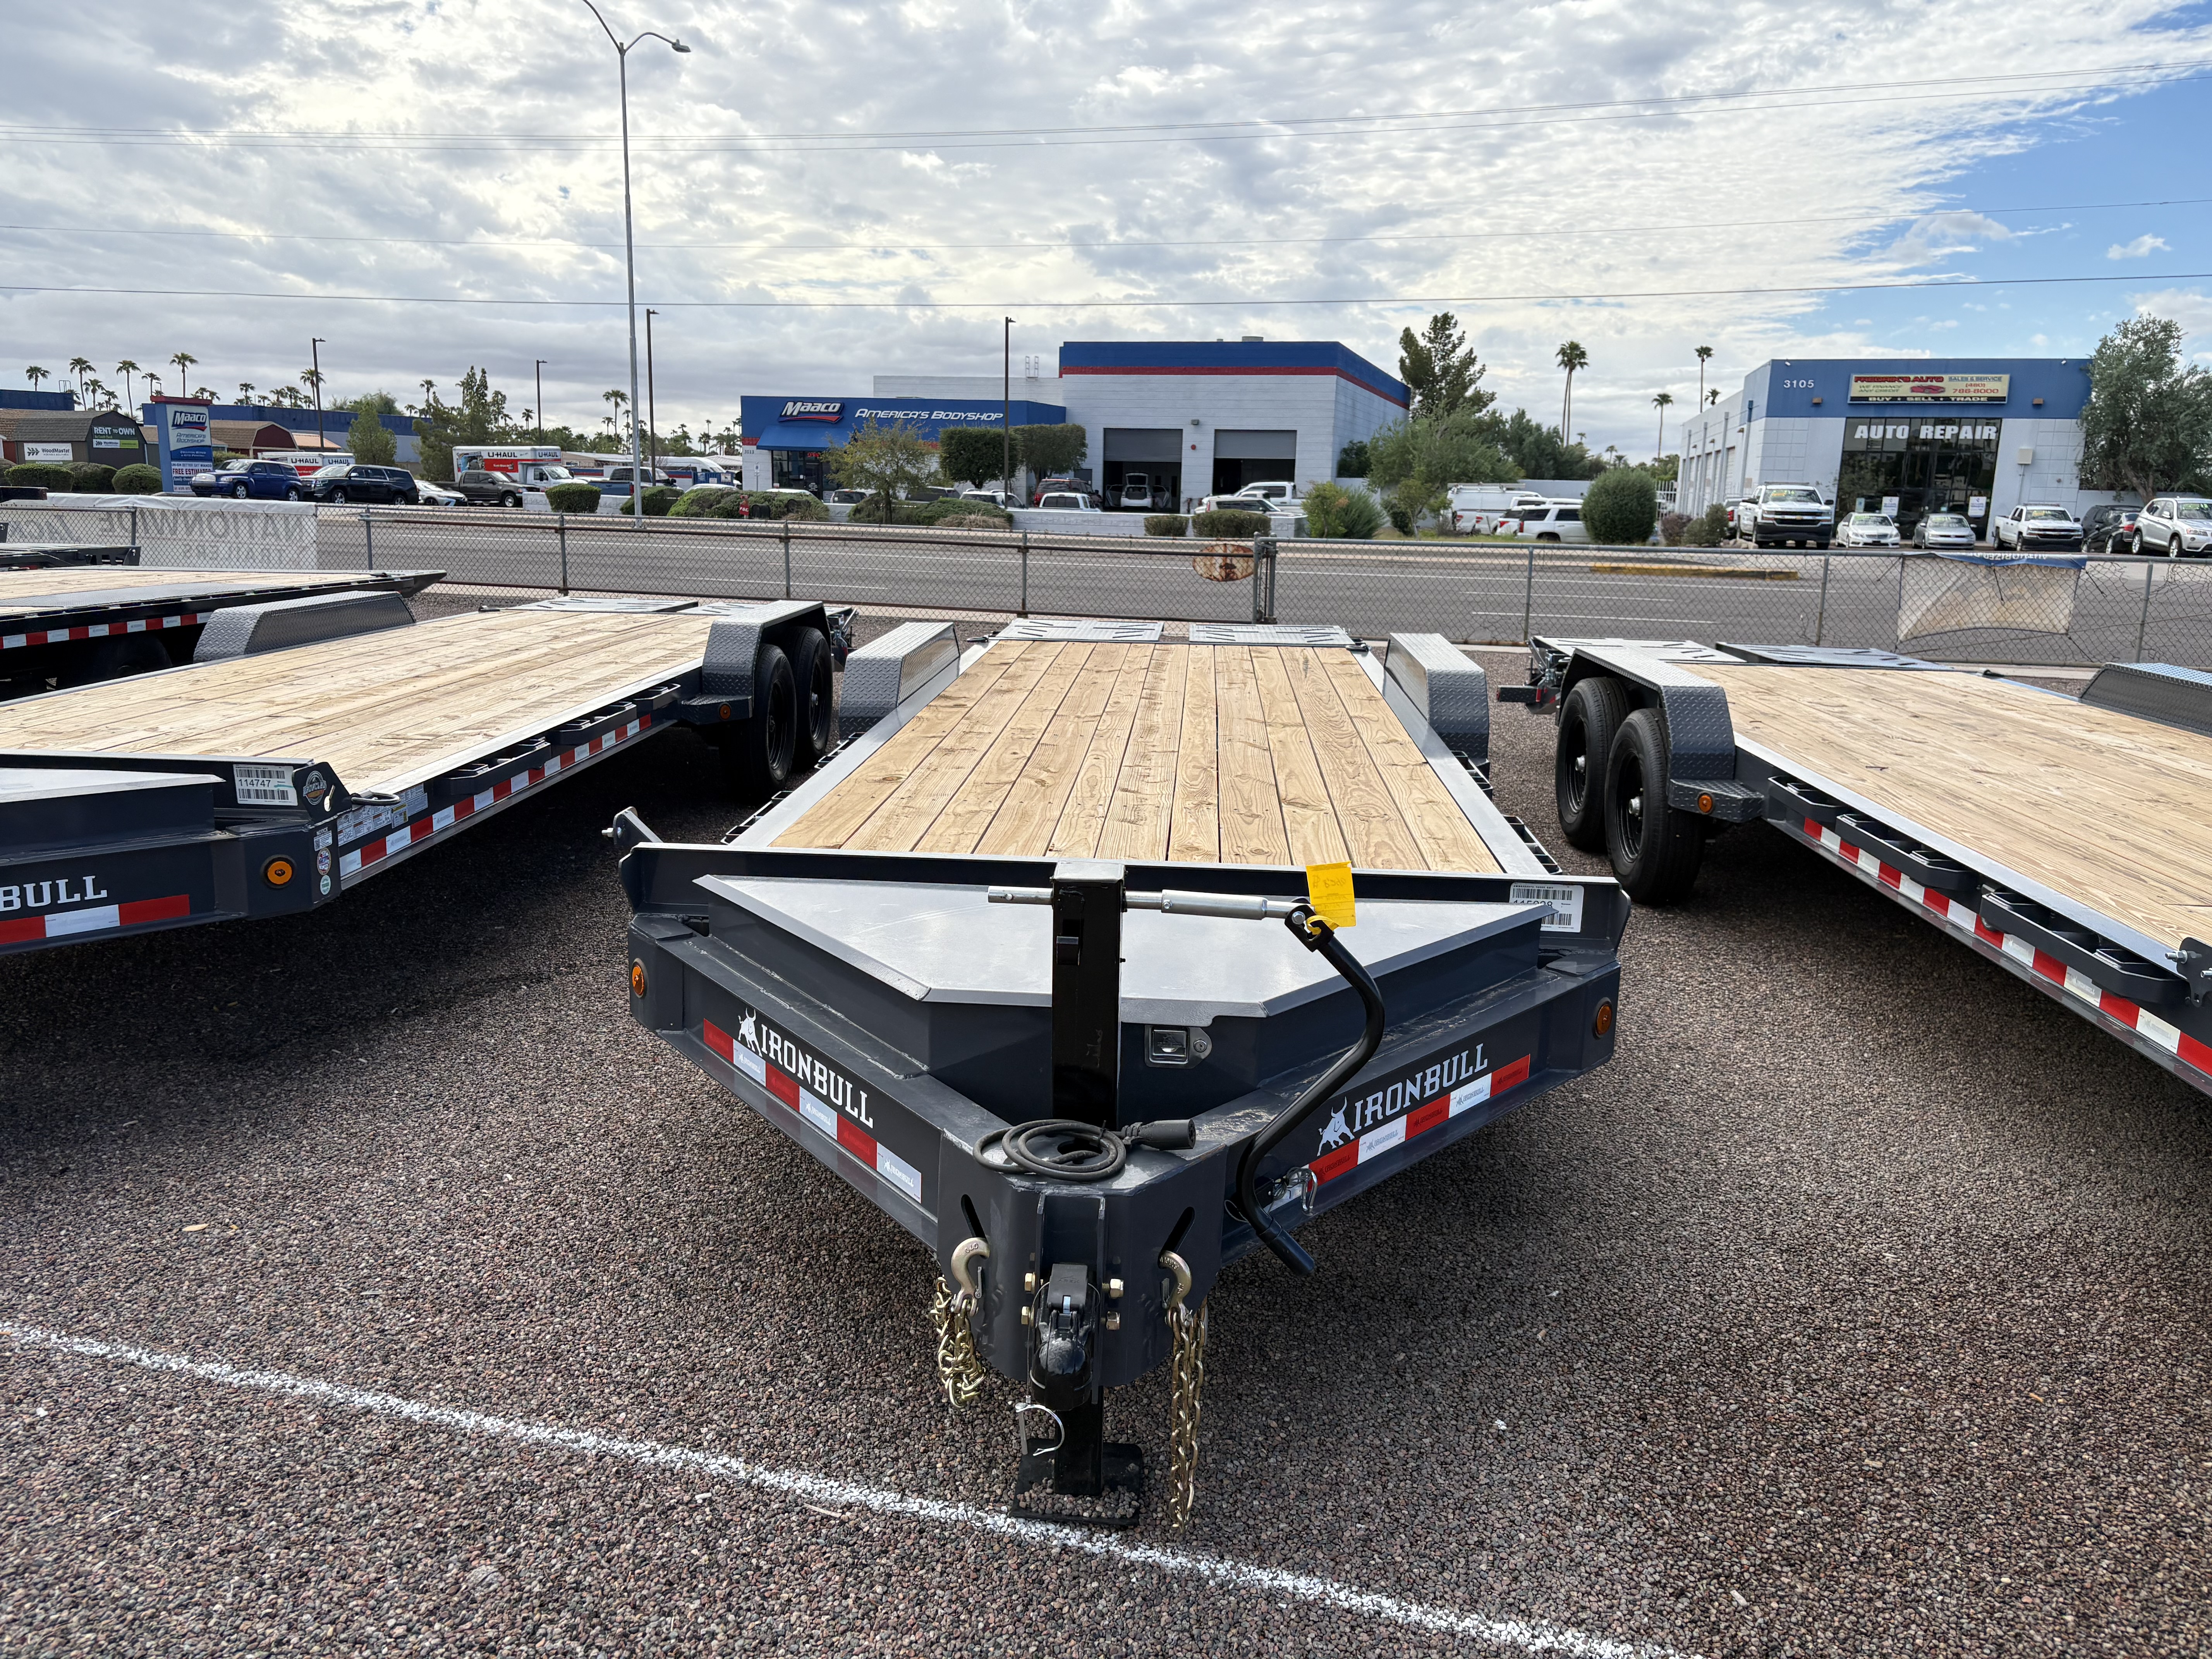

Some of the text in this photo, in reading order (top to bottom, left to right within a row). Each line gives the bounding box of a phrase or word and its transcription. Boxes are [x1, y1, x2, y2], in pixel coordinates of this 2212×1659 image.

[1783, 380, 1814, 388] 3105
[854, 409, 1004, 421] AMERICA'S BODYSHOP
[1854, 425, 1998, 439] AUTO REPAIR
[239, 779, 271, 787] 114747
[0, 875, 107, 912] BULL
[762, 1024, 873, 1128] IRONBULL
[1353, 1043, 1488, 1133] IRONBULL
[1375, 1130, 1398, 1147] IRONBULL
[891, 1164, 914, 1187] IRONBULL
